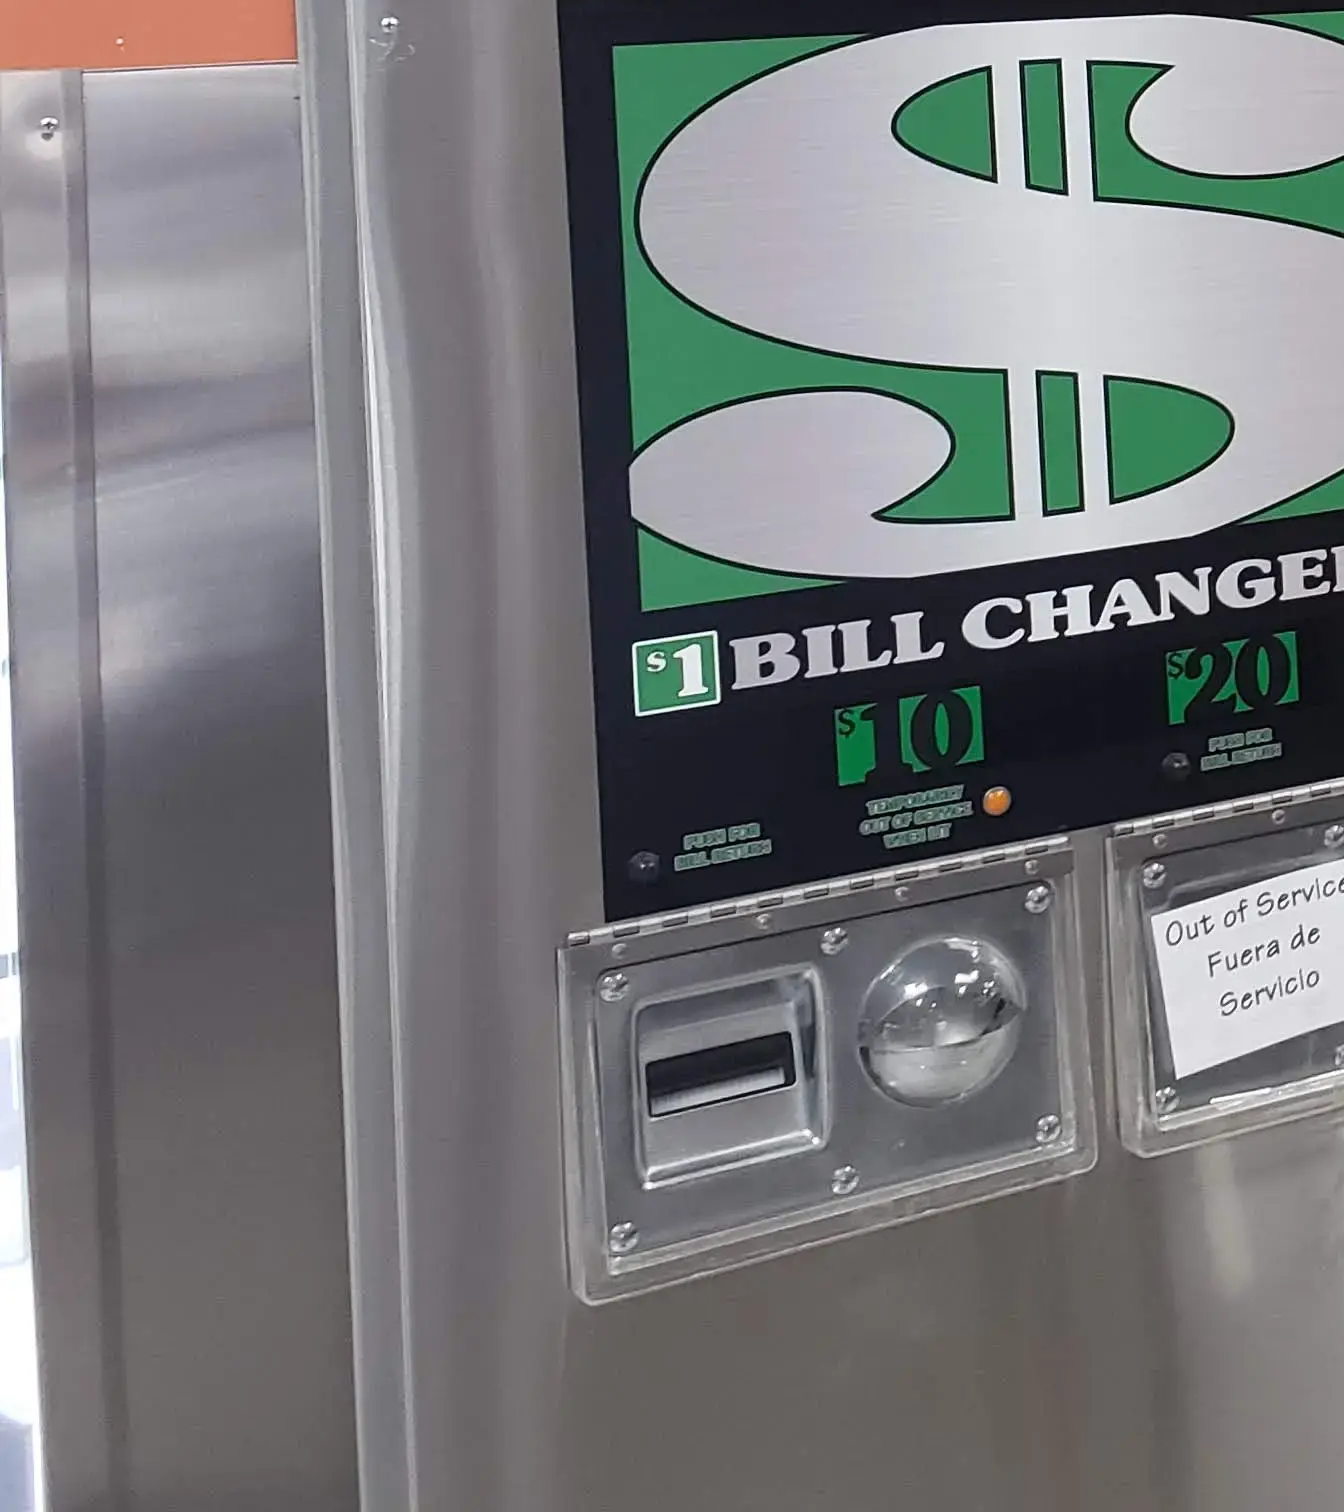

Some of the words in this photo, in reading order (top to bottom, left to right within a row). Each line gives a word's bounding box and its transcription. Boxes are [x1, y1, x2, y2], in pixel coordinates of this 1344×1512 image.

[645, 643, 710, 701] $1
[729, 614, 944, 691] BILL
[1168, 632, 1296, 722] $20
[838, 687, 980, 782] $10
[1165, 914, 1215, 947] Out
[1223, 898, 1249, 928] of
[1207, 938, 1280, 978] Fuera
[1290, 924, 1321, 950] de
[1219, 968, 1321, 1017] Servicio
